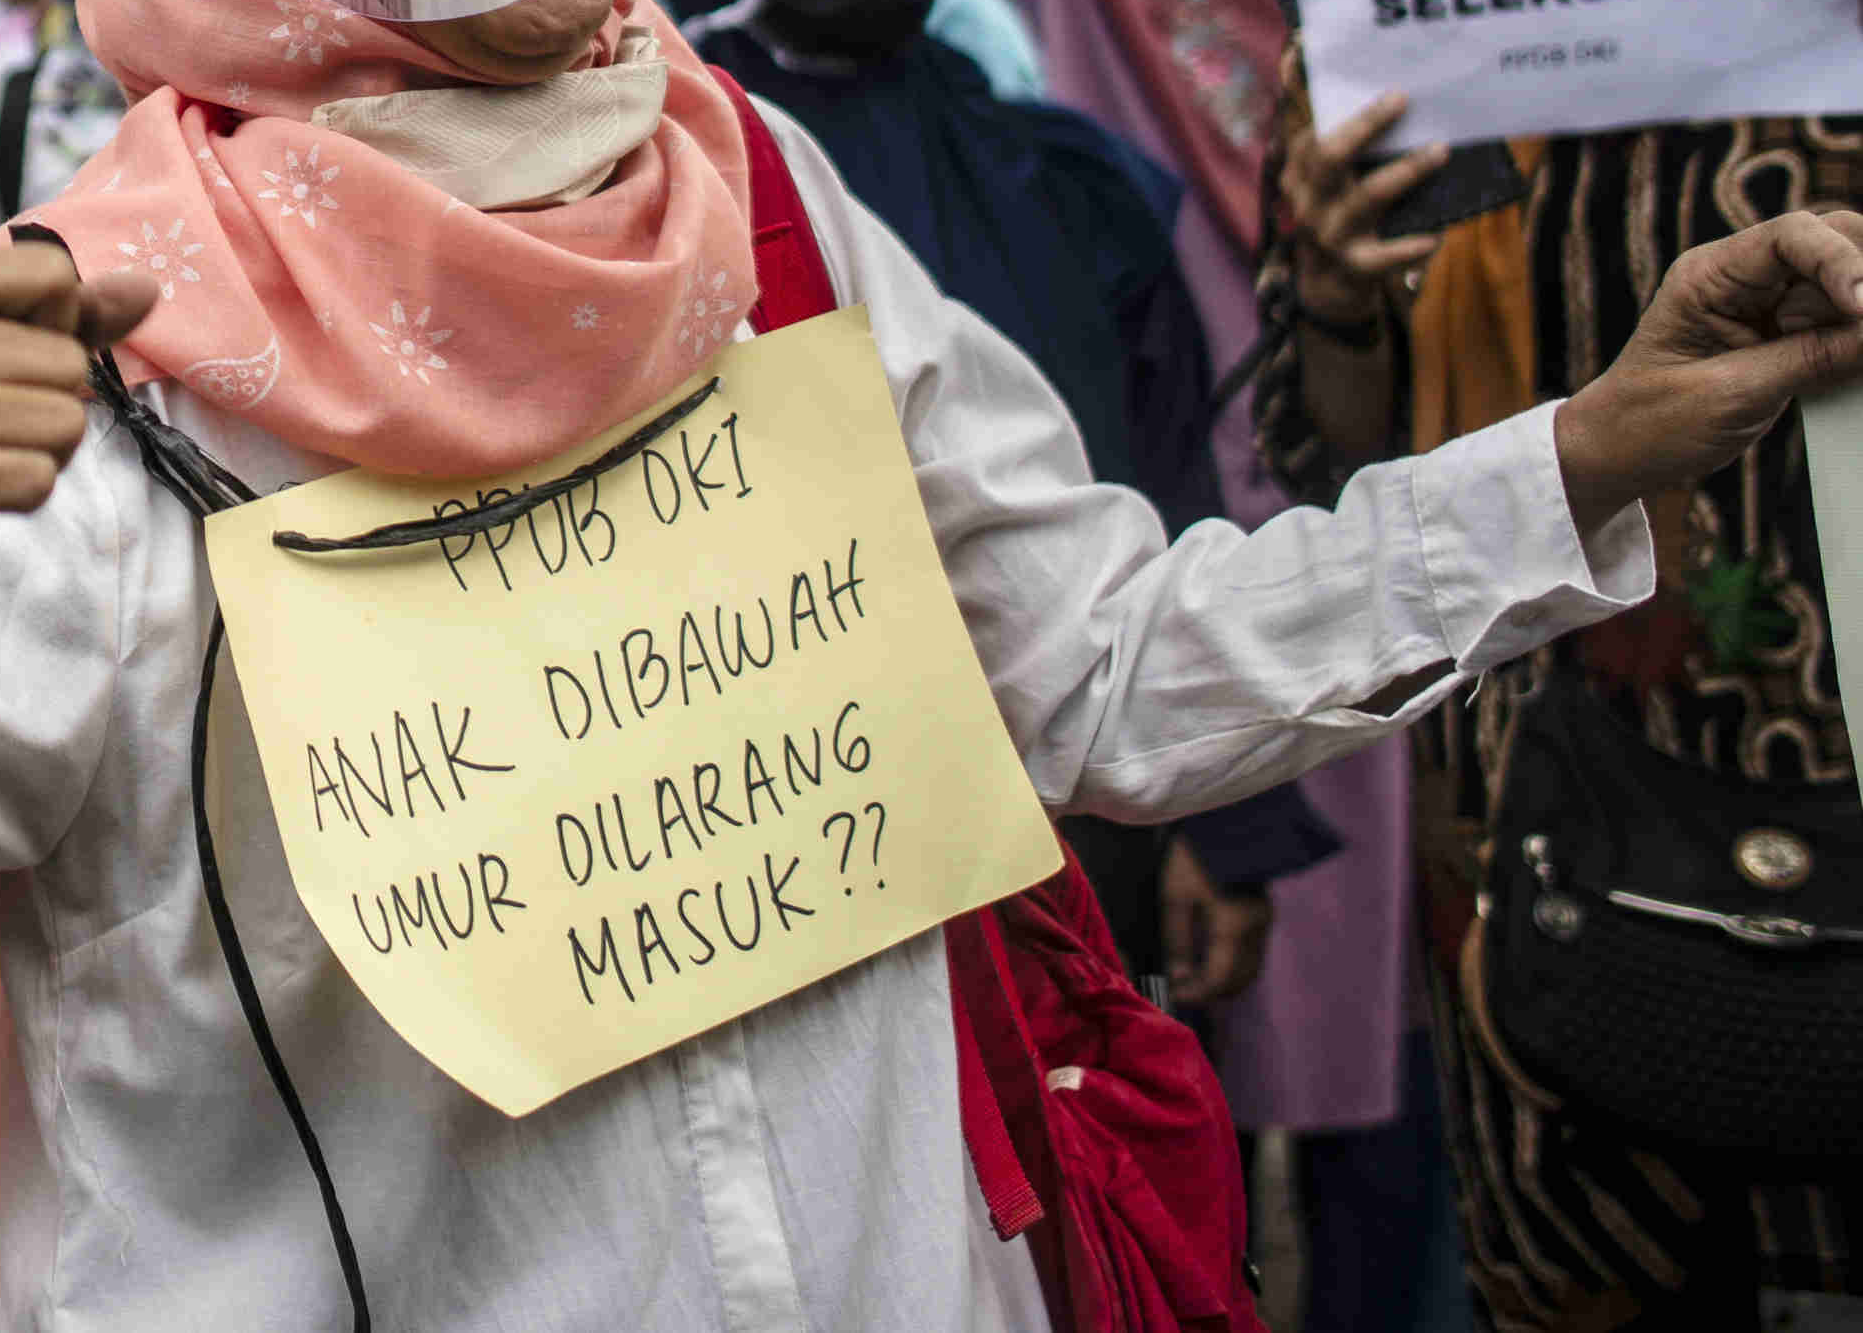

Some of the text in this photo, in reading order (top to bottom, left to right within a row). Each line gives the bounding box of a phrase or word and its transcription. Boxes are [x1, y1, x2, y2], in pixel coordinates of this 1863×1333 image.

[641, 412, 753, 524] DKI
[307, 538, 865, 838] ANAK DIBAWAH
[353, 701, 870, 955] UMUR DILARANG
